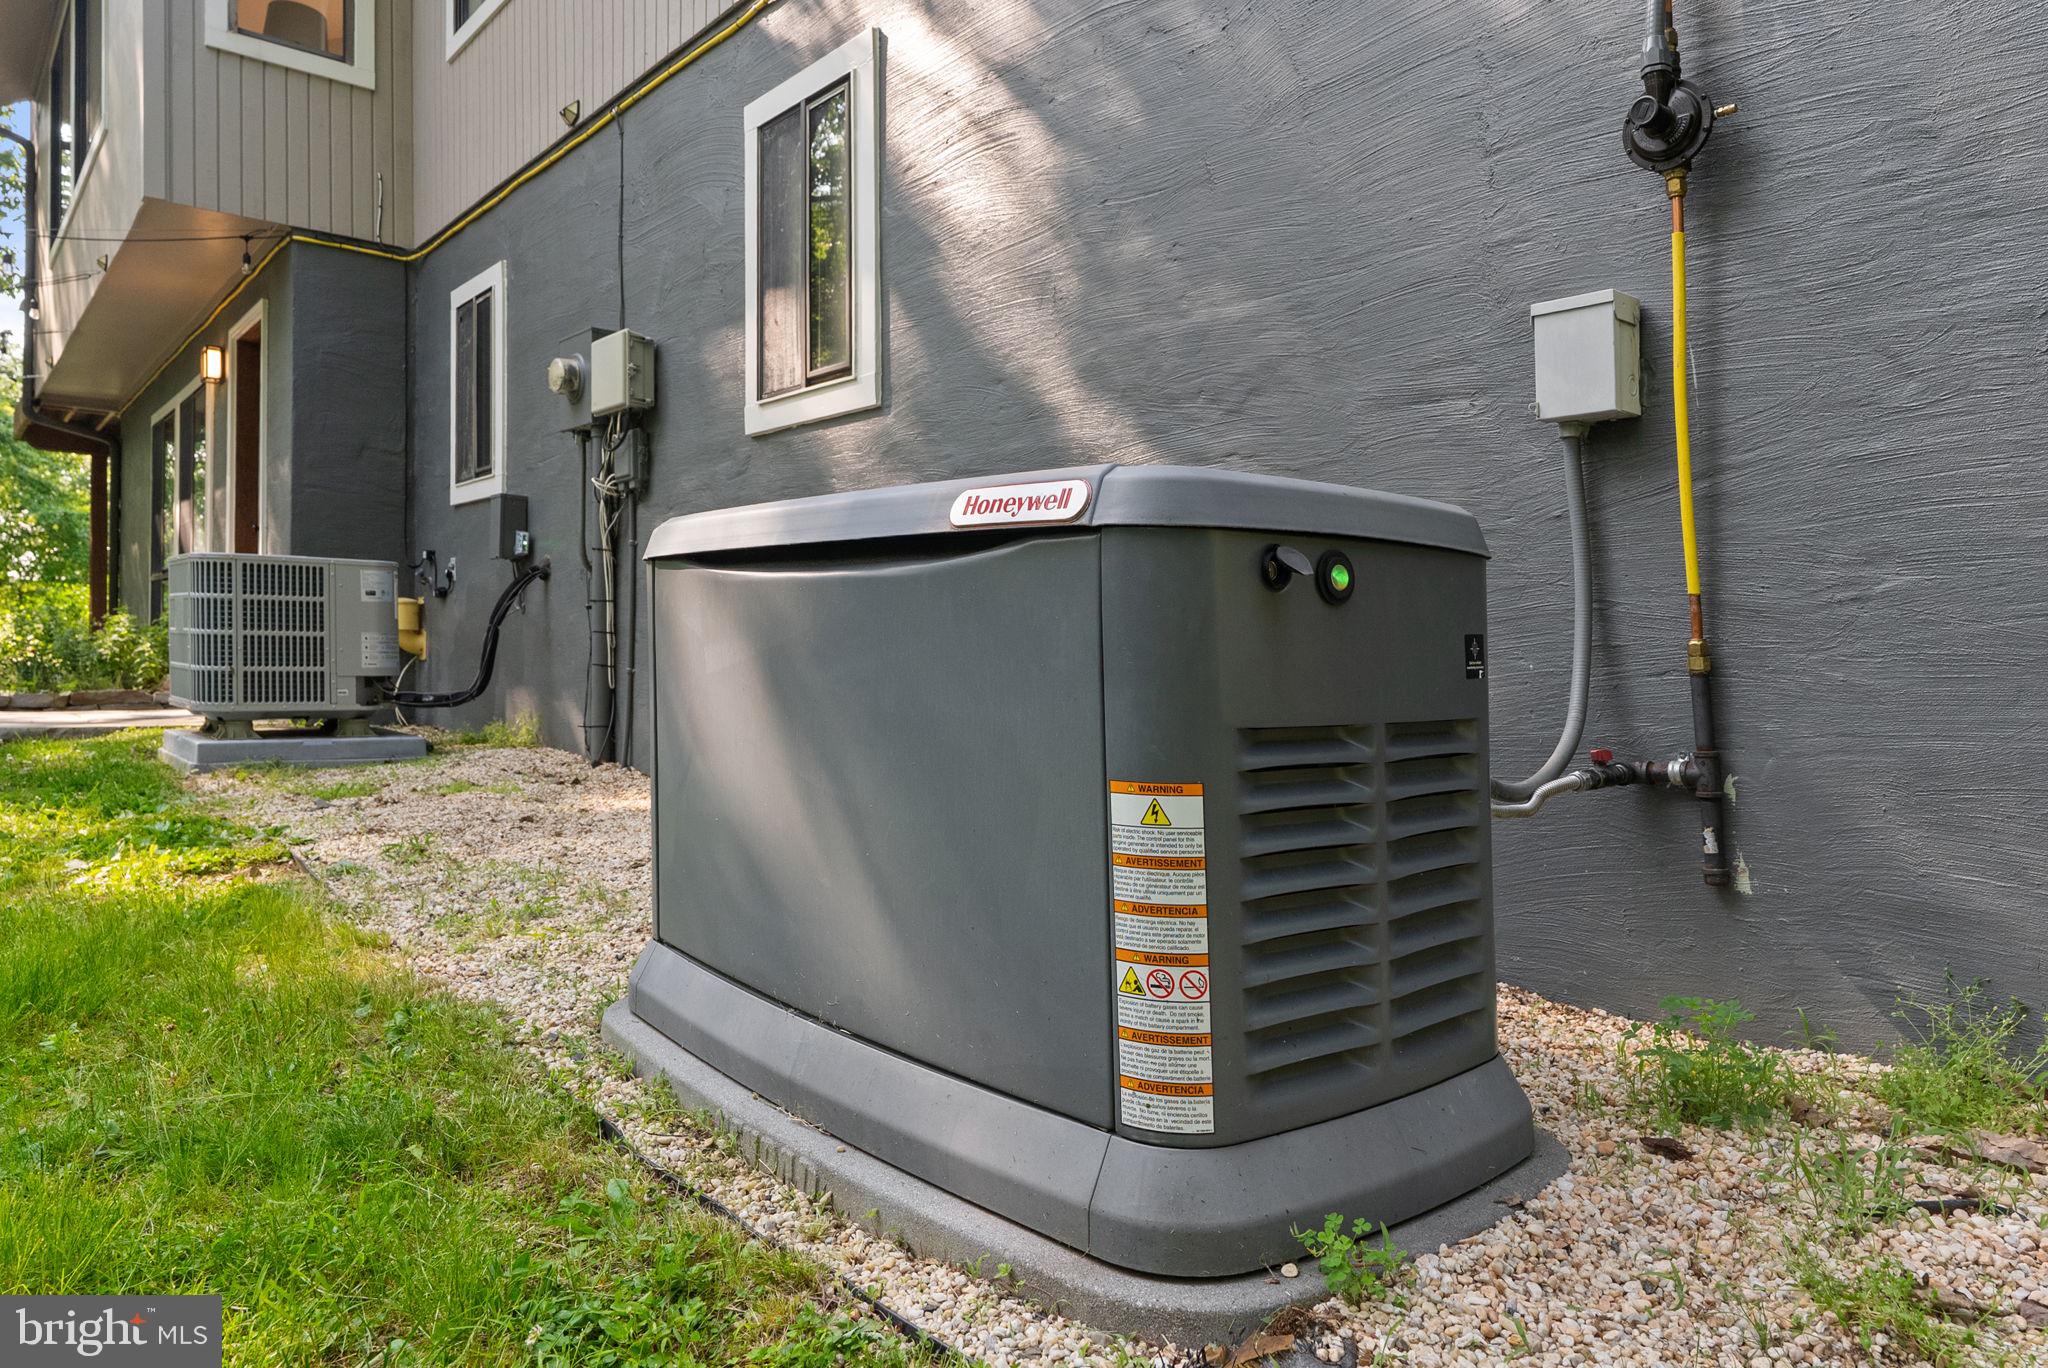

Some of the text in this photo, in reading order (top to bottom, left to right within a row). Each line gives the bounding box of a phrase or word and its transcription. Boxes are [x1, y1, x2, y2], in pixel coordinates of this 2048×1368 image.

[962, 487, 1073, 517] Honeywell
[1138, 785, 1183, 793] WARNING
[1126, 857, 1202, 867] AVERTISSEMENT
[1132, 905, 1198, 915] ADVERTENCIA
[1144, 955, 1189, 964] WARNING
[1132, 1032, 1208, 1044] AVERTISSEMENT
[1138, 1082, 1204, 1094] ADVERTENCIA
